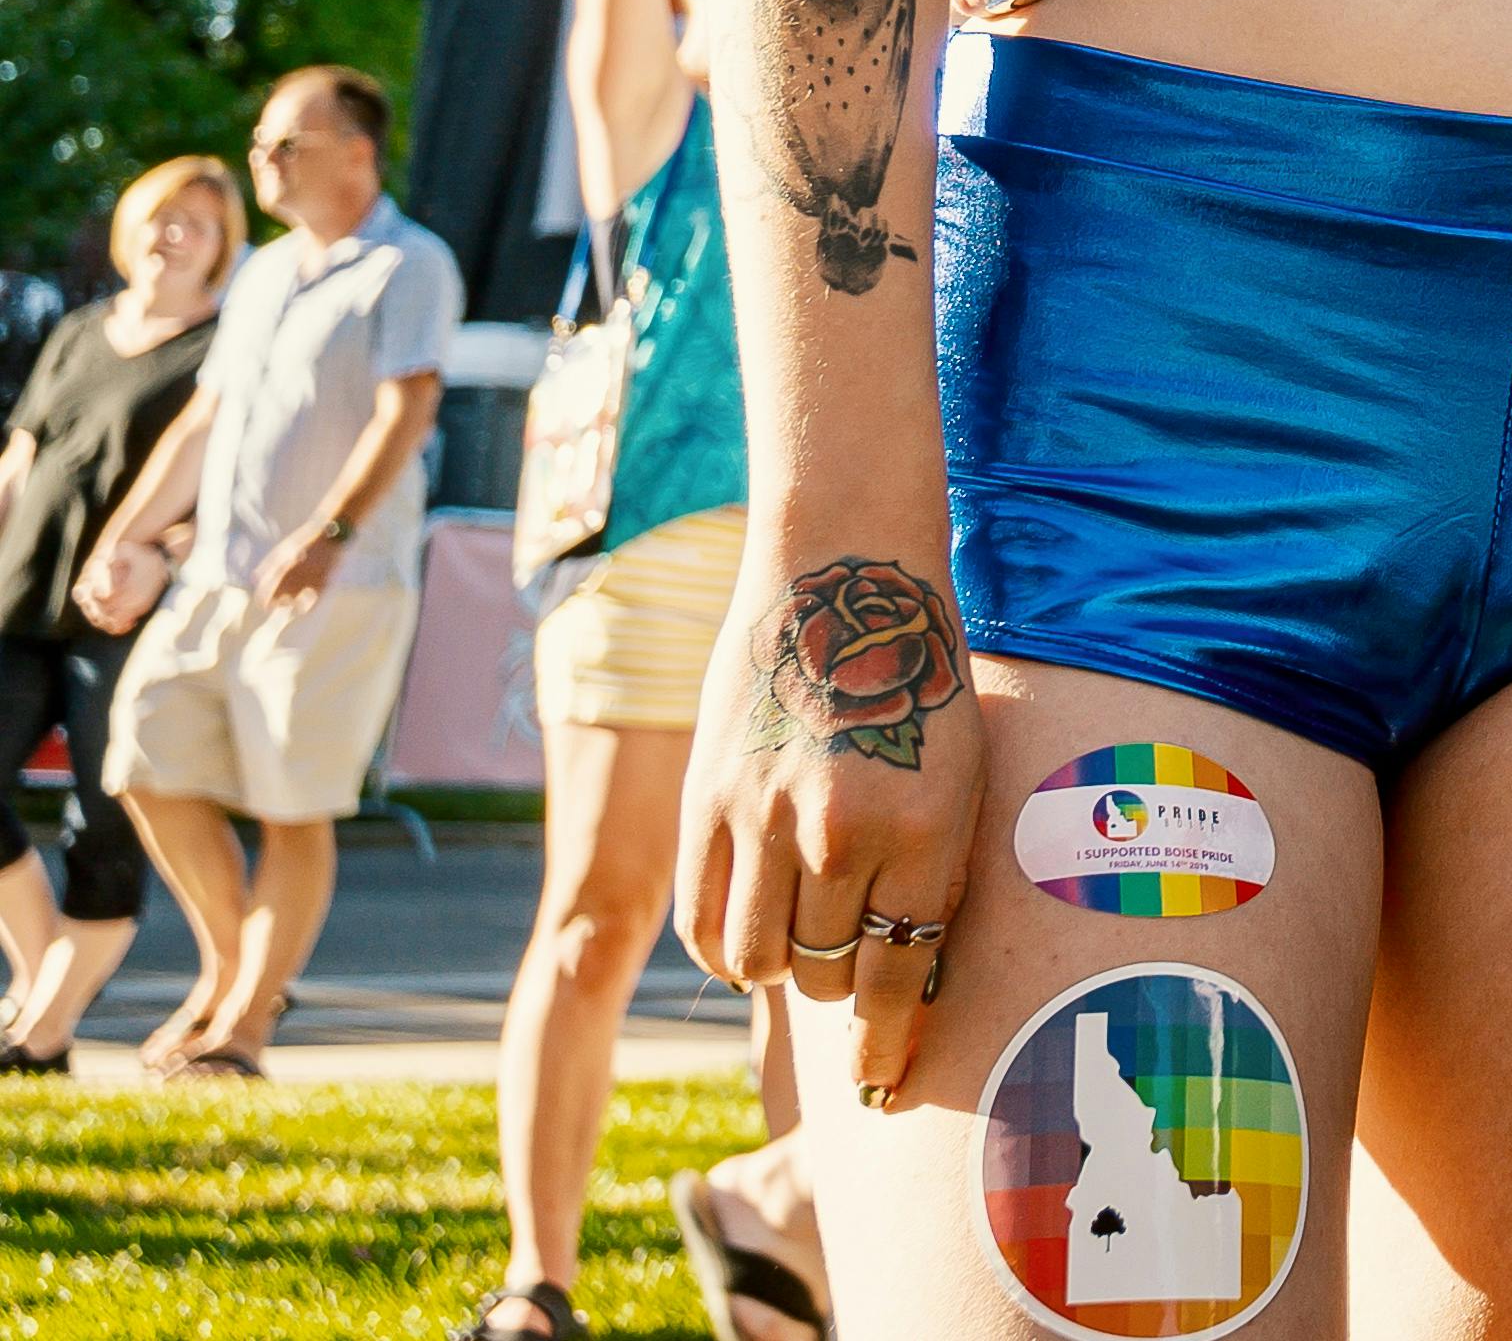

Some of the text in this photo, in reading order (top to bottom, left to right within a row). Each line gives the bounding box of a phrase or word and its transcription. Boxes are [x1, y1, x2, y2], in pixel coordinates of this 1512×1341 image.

[1158, 805, 1220, 825] PRIDE
[1076, 846, 1234, 864] I SUPPORTED BOISE PRIDE
